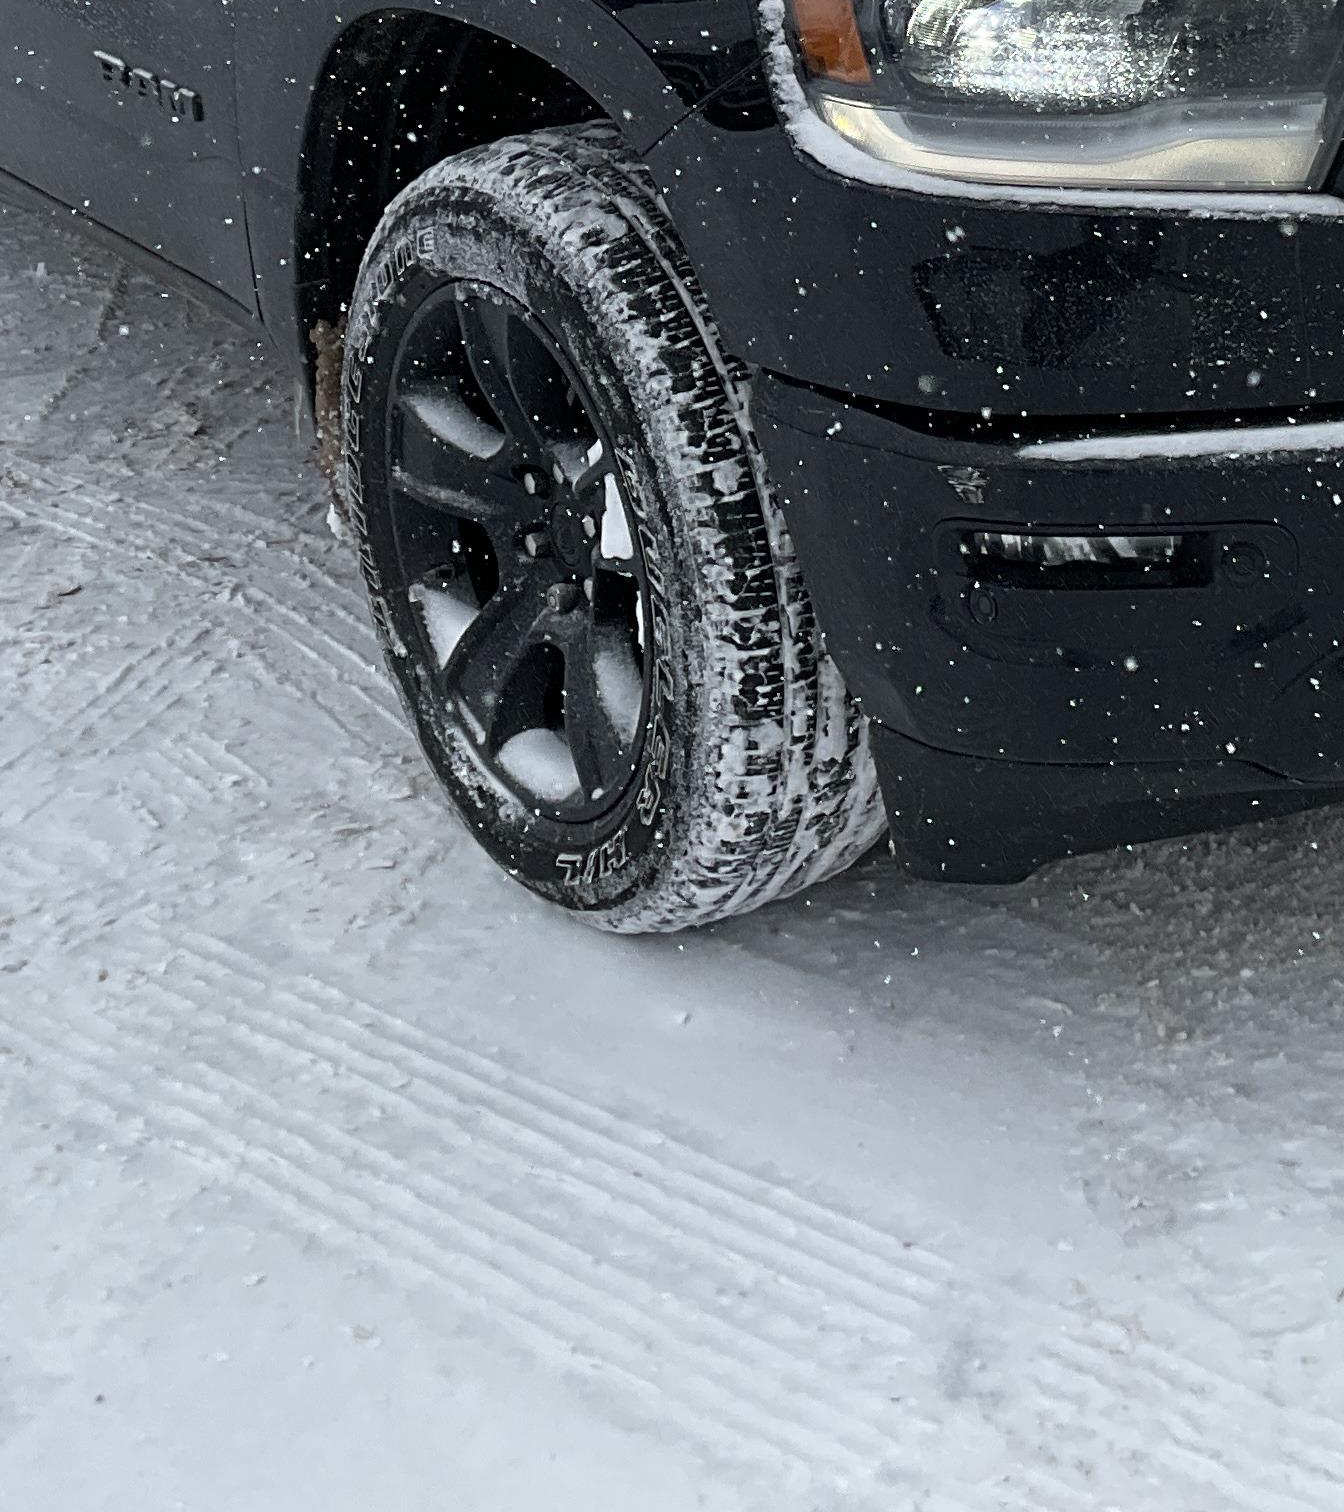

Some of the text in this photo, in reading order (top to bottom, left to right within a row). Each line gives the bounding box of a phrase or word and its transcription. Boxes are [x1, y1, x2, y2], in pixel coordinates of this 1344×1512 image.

[93, 50, 205, 122] RAM
[556, 447, 674, 887] DUELER H/L
